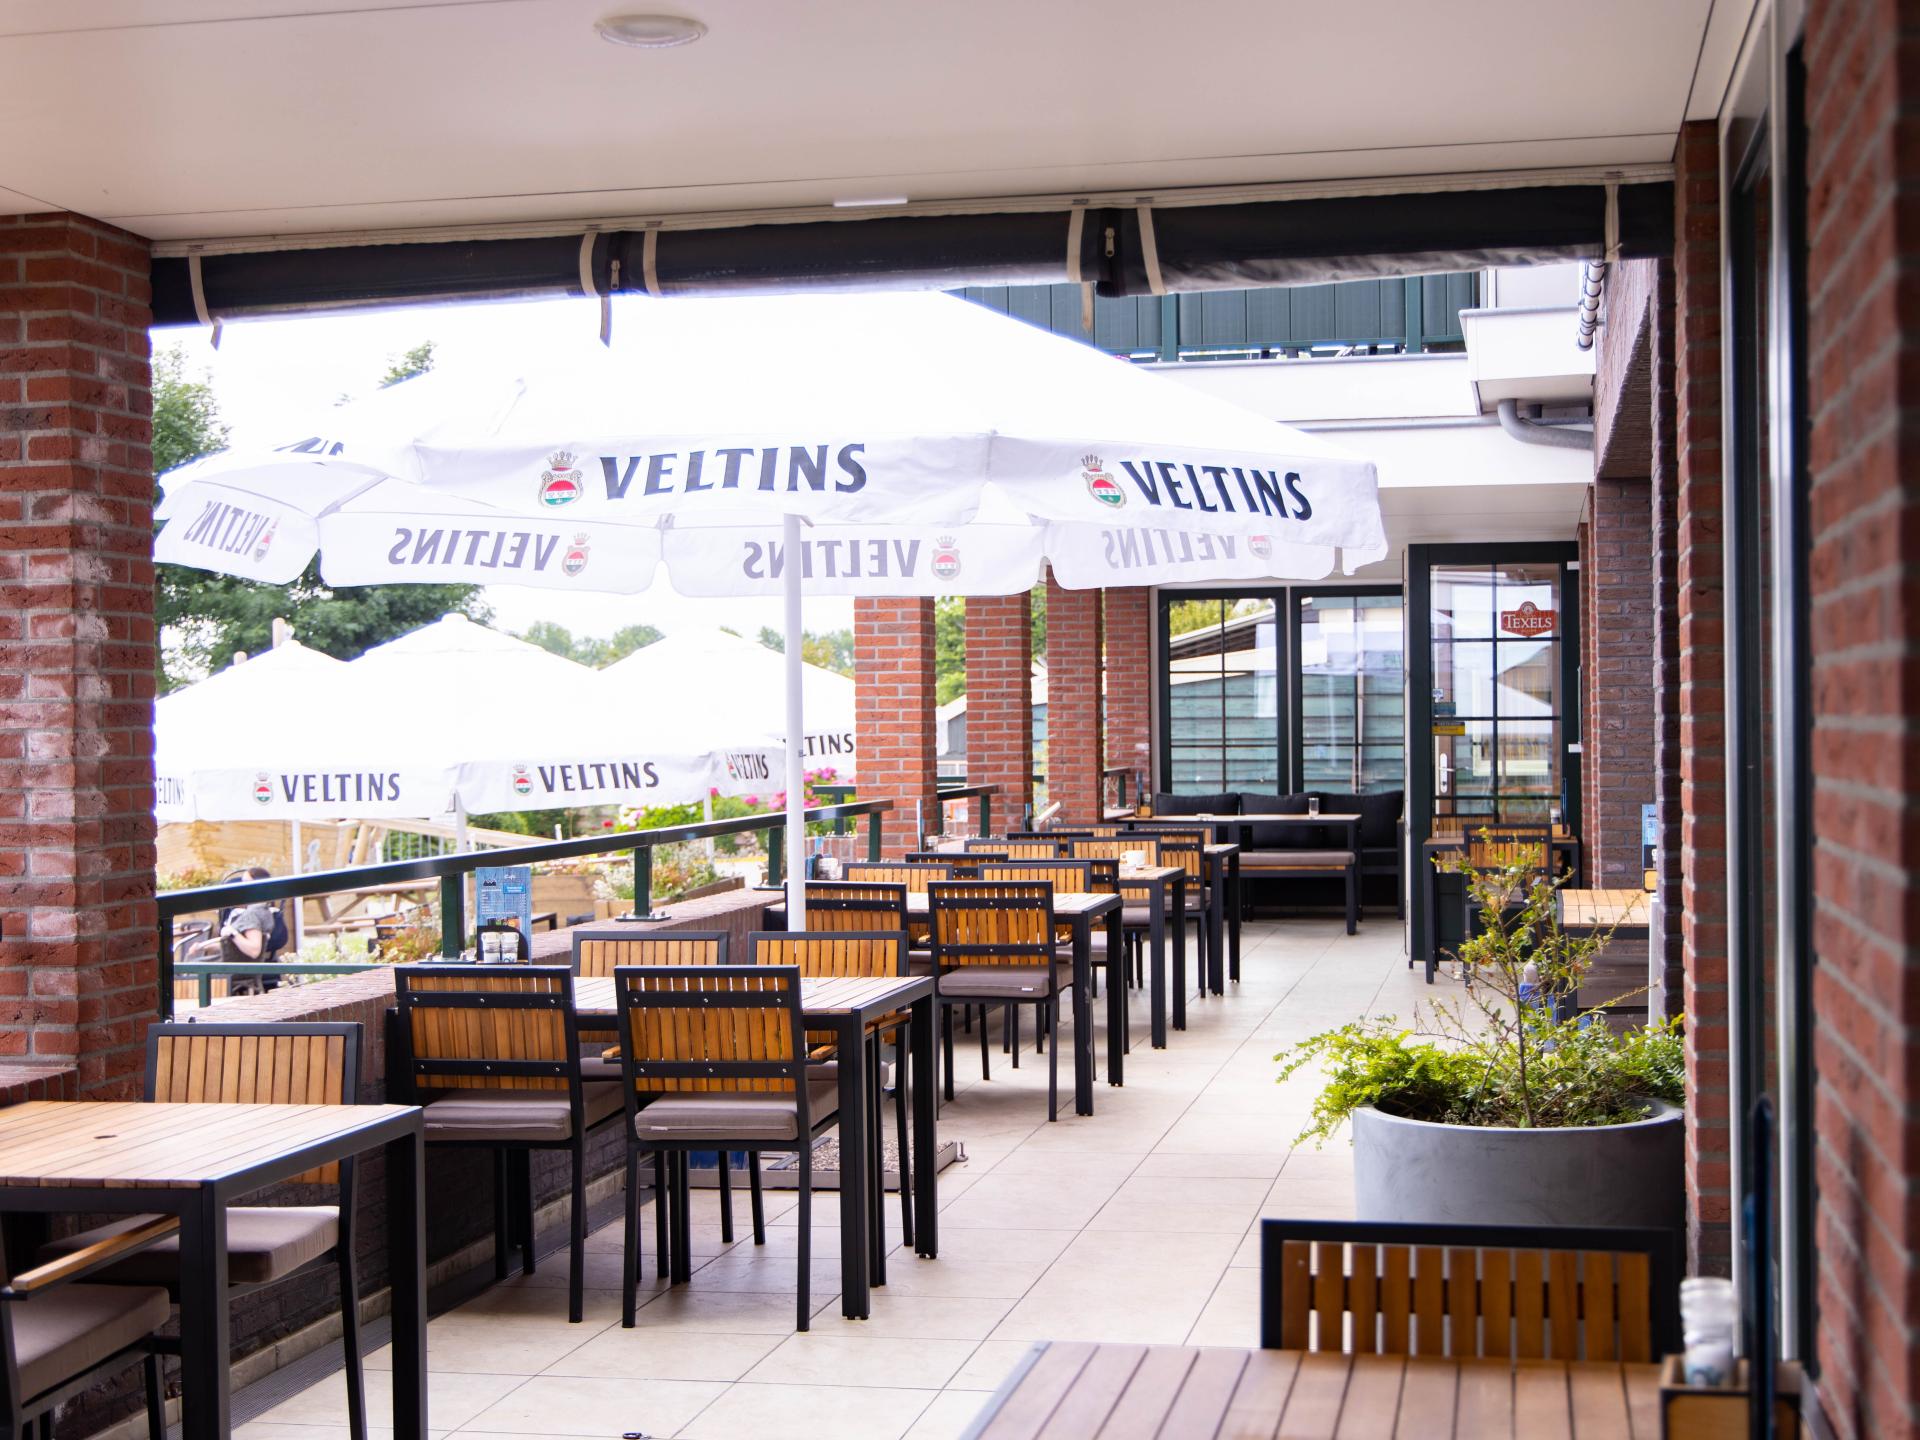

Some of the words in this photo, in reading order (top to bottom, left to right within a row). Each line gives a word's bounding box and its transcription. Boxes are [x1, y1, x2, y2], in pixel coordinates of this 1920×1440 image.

[599, 443, 867, 500] VELTINS
[1119, 461, 1313, 521] VELTINS
[1503, 614, 1552, 629] TEXELS
[280, 773, 401, 802] VELTINS
[537, 761, 660, 793] VELTINS
